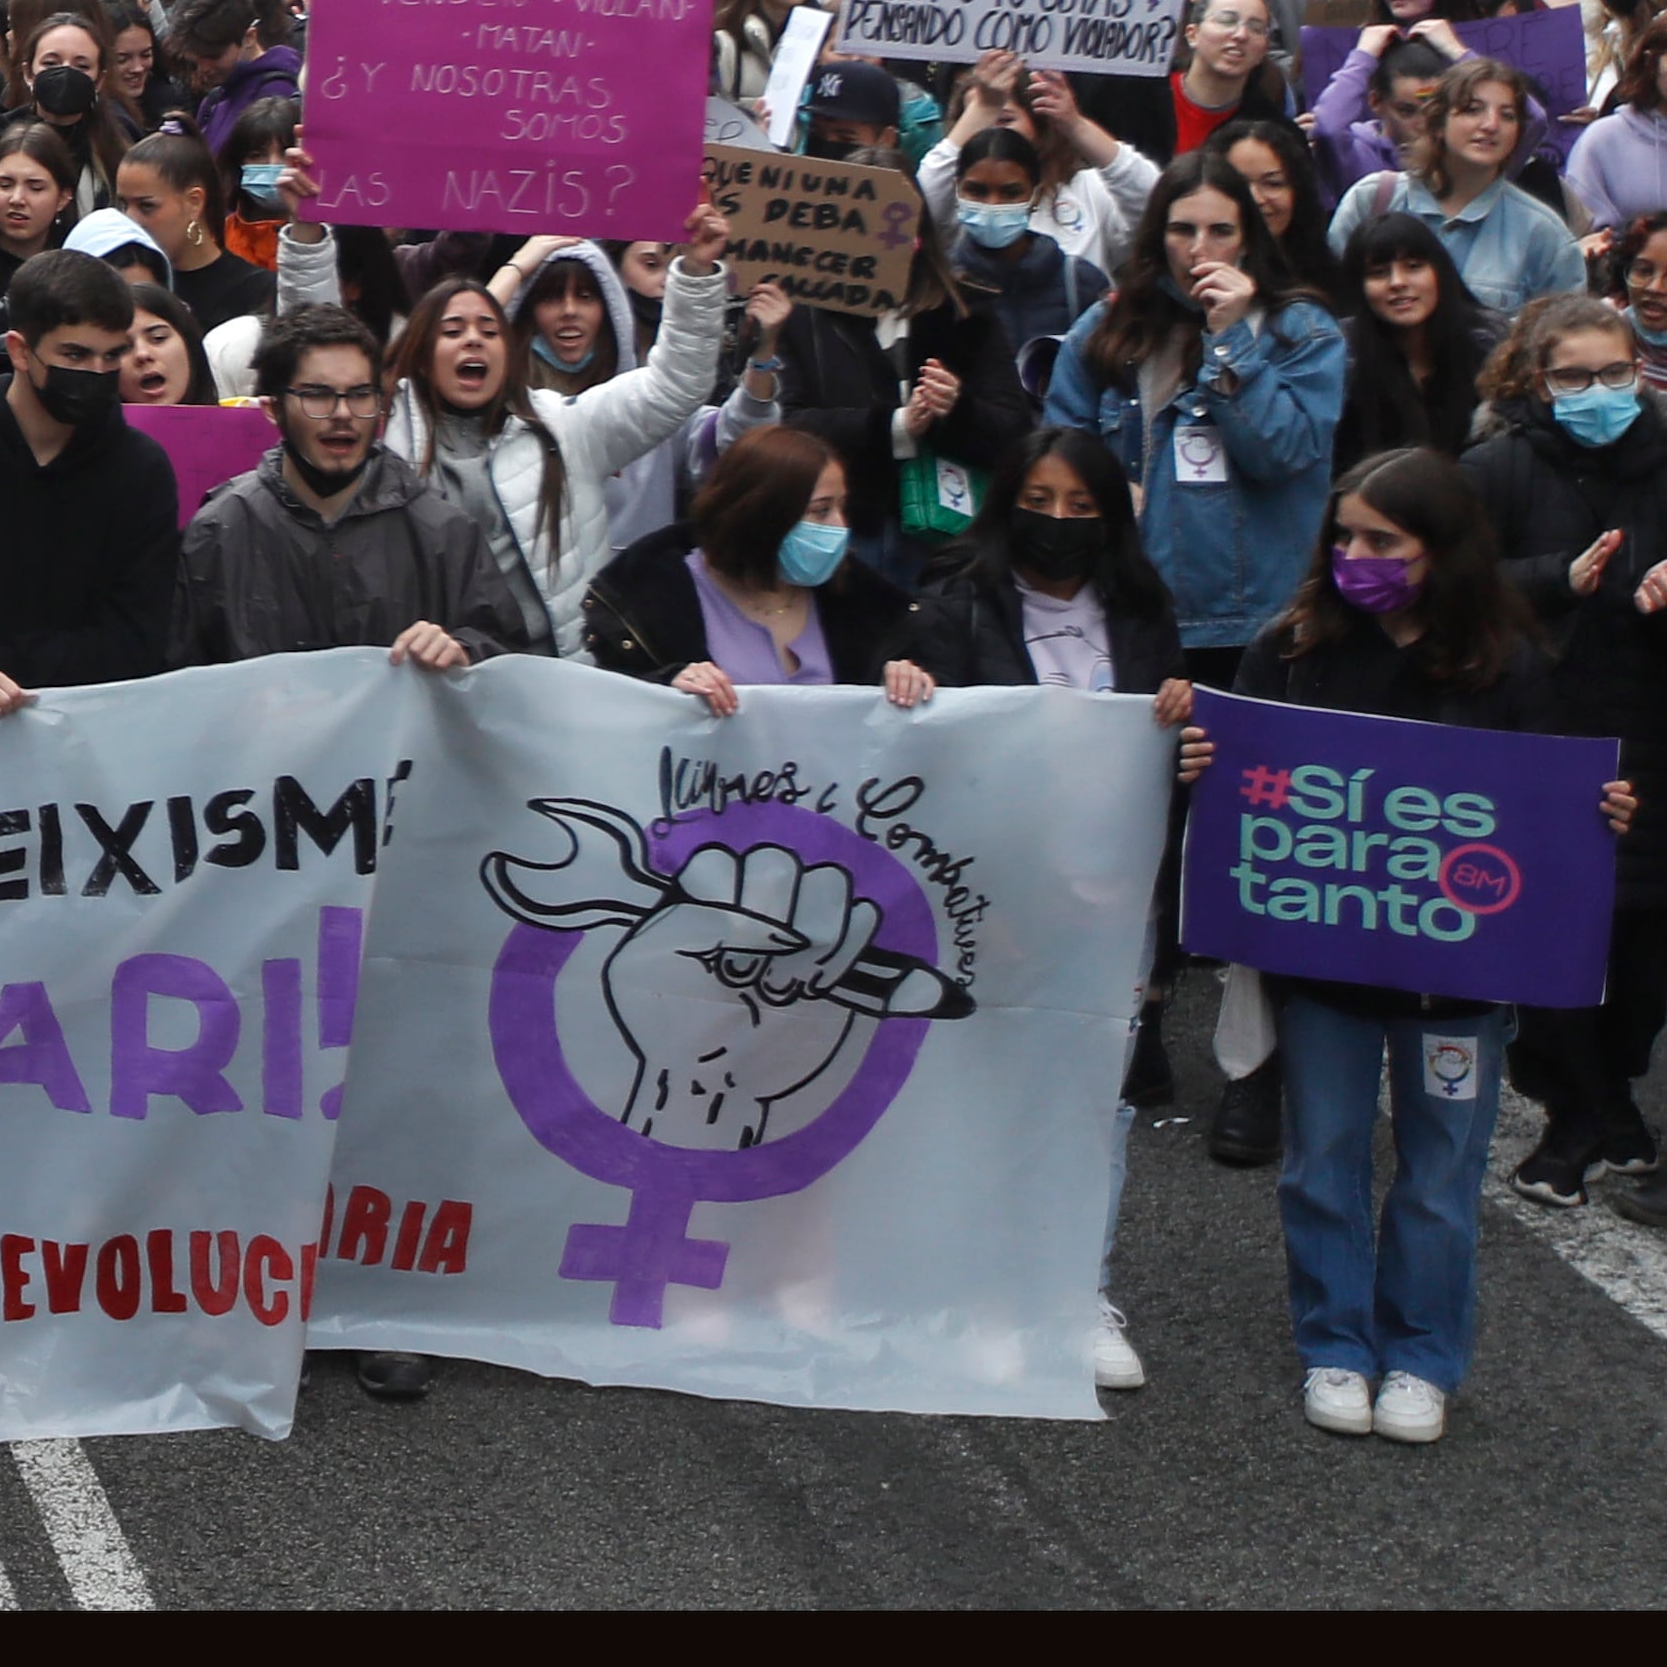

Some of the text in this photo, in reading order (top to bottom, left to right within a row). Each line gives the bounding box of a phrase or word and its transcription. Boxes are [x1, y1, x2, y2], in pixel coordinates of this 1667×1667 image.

[842, 0, 1178, 64] PENSANDO COMO VIOLADOR?
[410, 64, 612, 109] NOSOTRAS
[499, 109, 628, 145] SOMOS
[315, 170, 390, 208] LAS
[801, 173, 878, 202] UNA
[763, 198, 868, 235] DEBA
[1384, 790, 1496, 839] es
[1239, 811, 1443, 883] para
[1452, 862, 1508, 899] 8M
[1230, 863, 1477, 944] tanto
